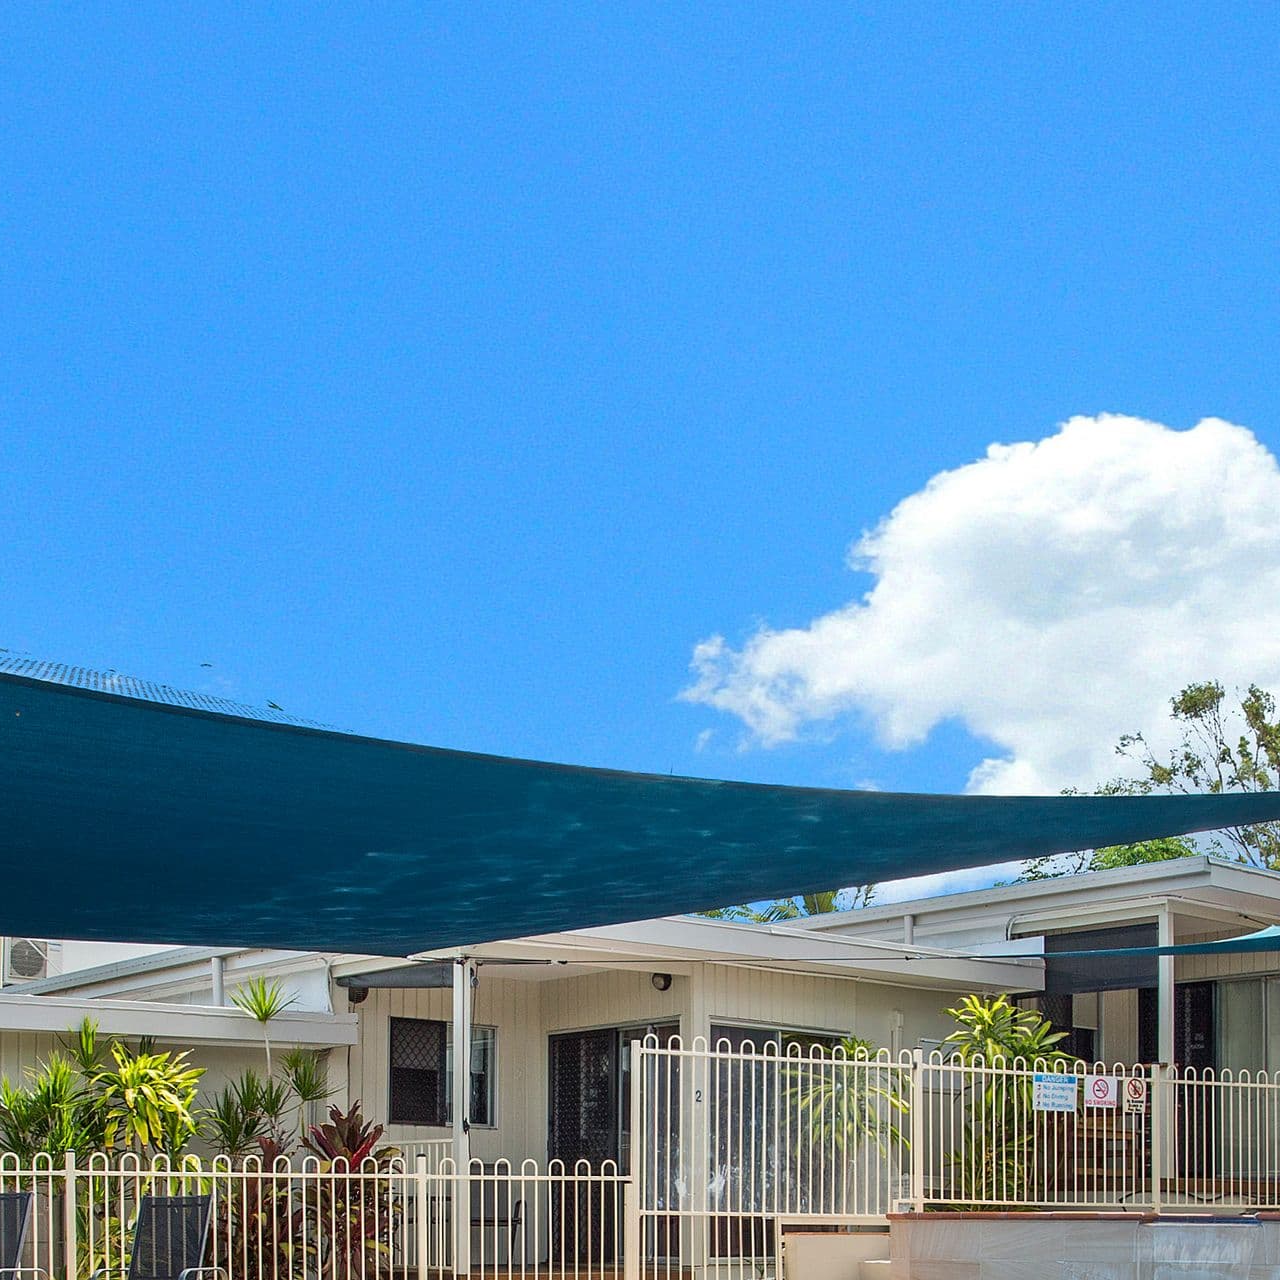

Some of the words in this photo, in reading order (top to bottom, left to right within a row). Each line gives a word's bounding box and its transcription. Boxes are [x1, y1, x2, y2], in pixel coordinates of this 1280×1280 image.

[1042, 1075, 1069, 1083] DANGER
[1052, 1085, 1074, 1093] Jumping
[695, 1090, 702, 1102] 2
[1051, 1093, 1069, 1101] Diving
[1051, 1102, 1073, 1110] Running
